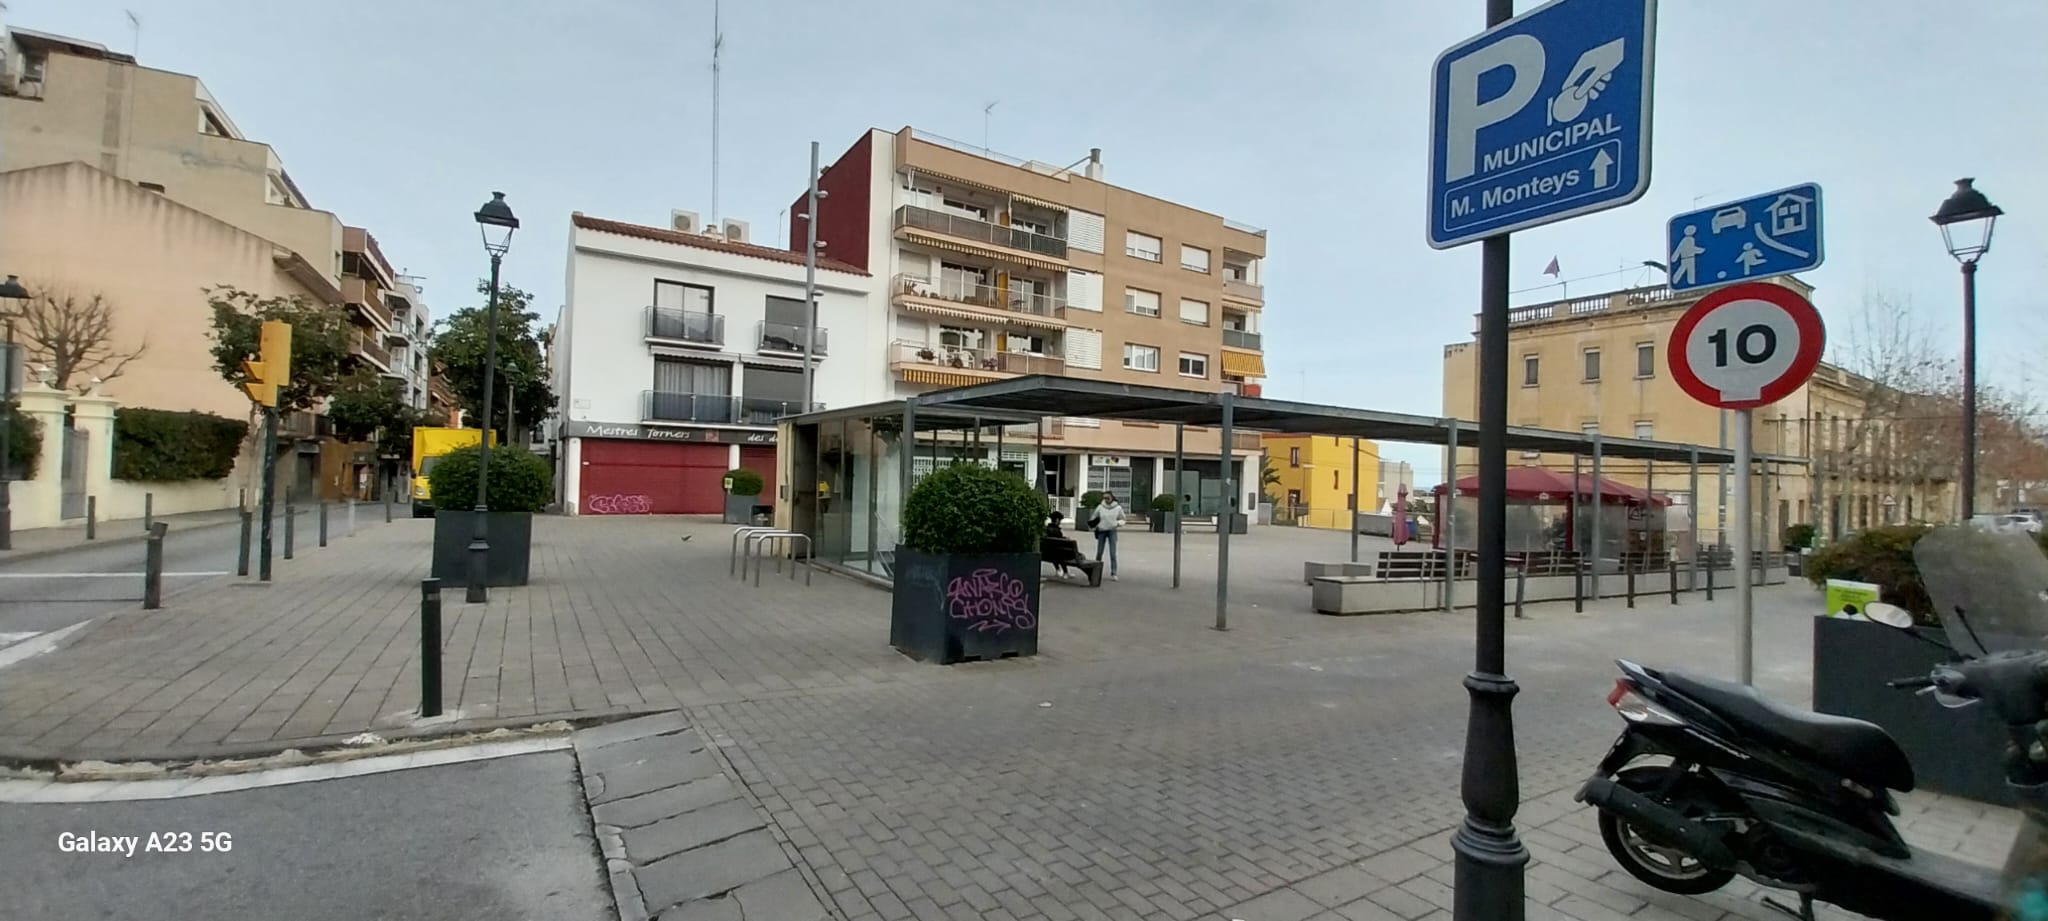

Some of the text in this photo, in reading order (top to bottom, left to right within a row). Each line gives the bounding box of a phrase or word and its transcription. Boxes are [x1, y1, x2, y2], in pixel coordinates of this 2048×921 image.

[1446, 34, 1546, 184] P
[1483, 113, 1622, 173] MUNICIPAL
[1451, 168, 1580, 219] M. Monteys
[1708, 324, 1777, 367] 10
